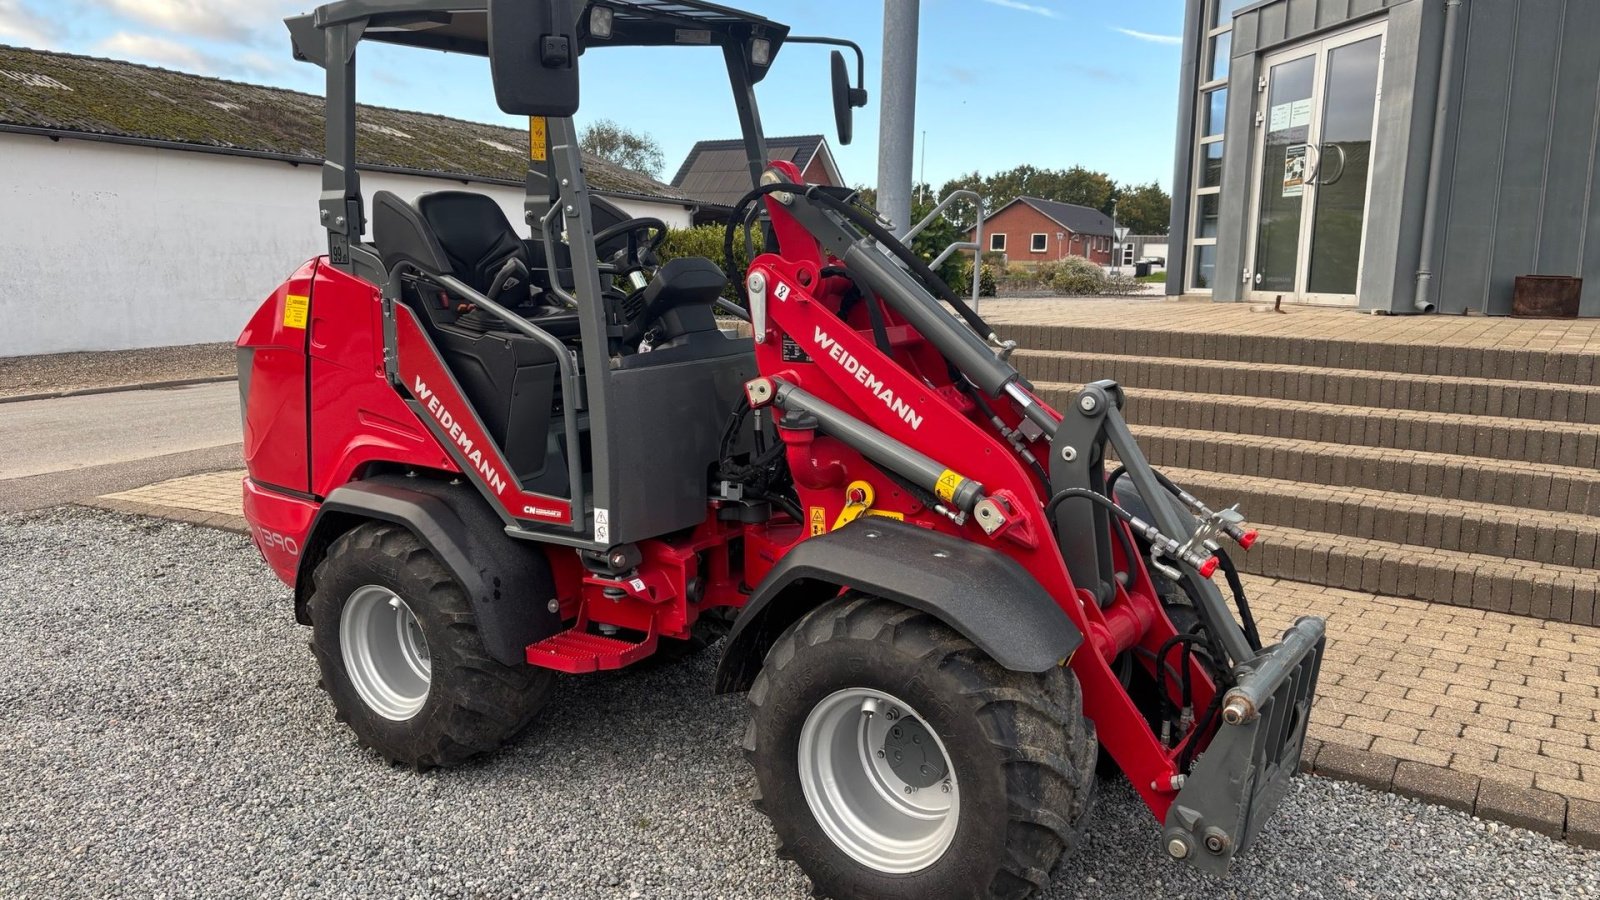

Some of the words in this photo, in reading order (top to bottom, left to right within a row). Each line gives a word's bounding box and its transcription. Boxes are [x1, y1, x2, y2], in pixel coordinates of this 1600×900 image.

[813, 325, 924, 431] WEIDEMANN
[414, 374, 507, 496] WEIDEMANN
[523, 505, 536, 515] CN
